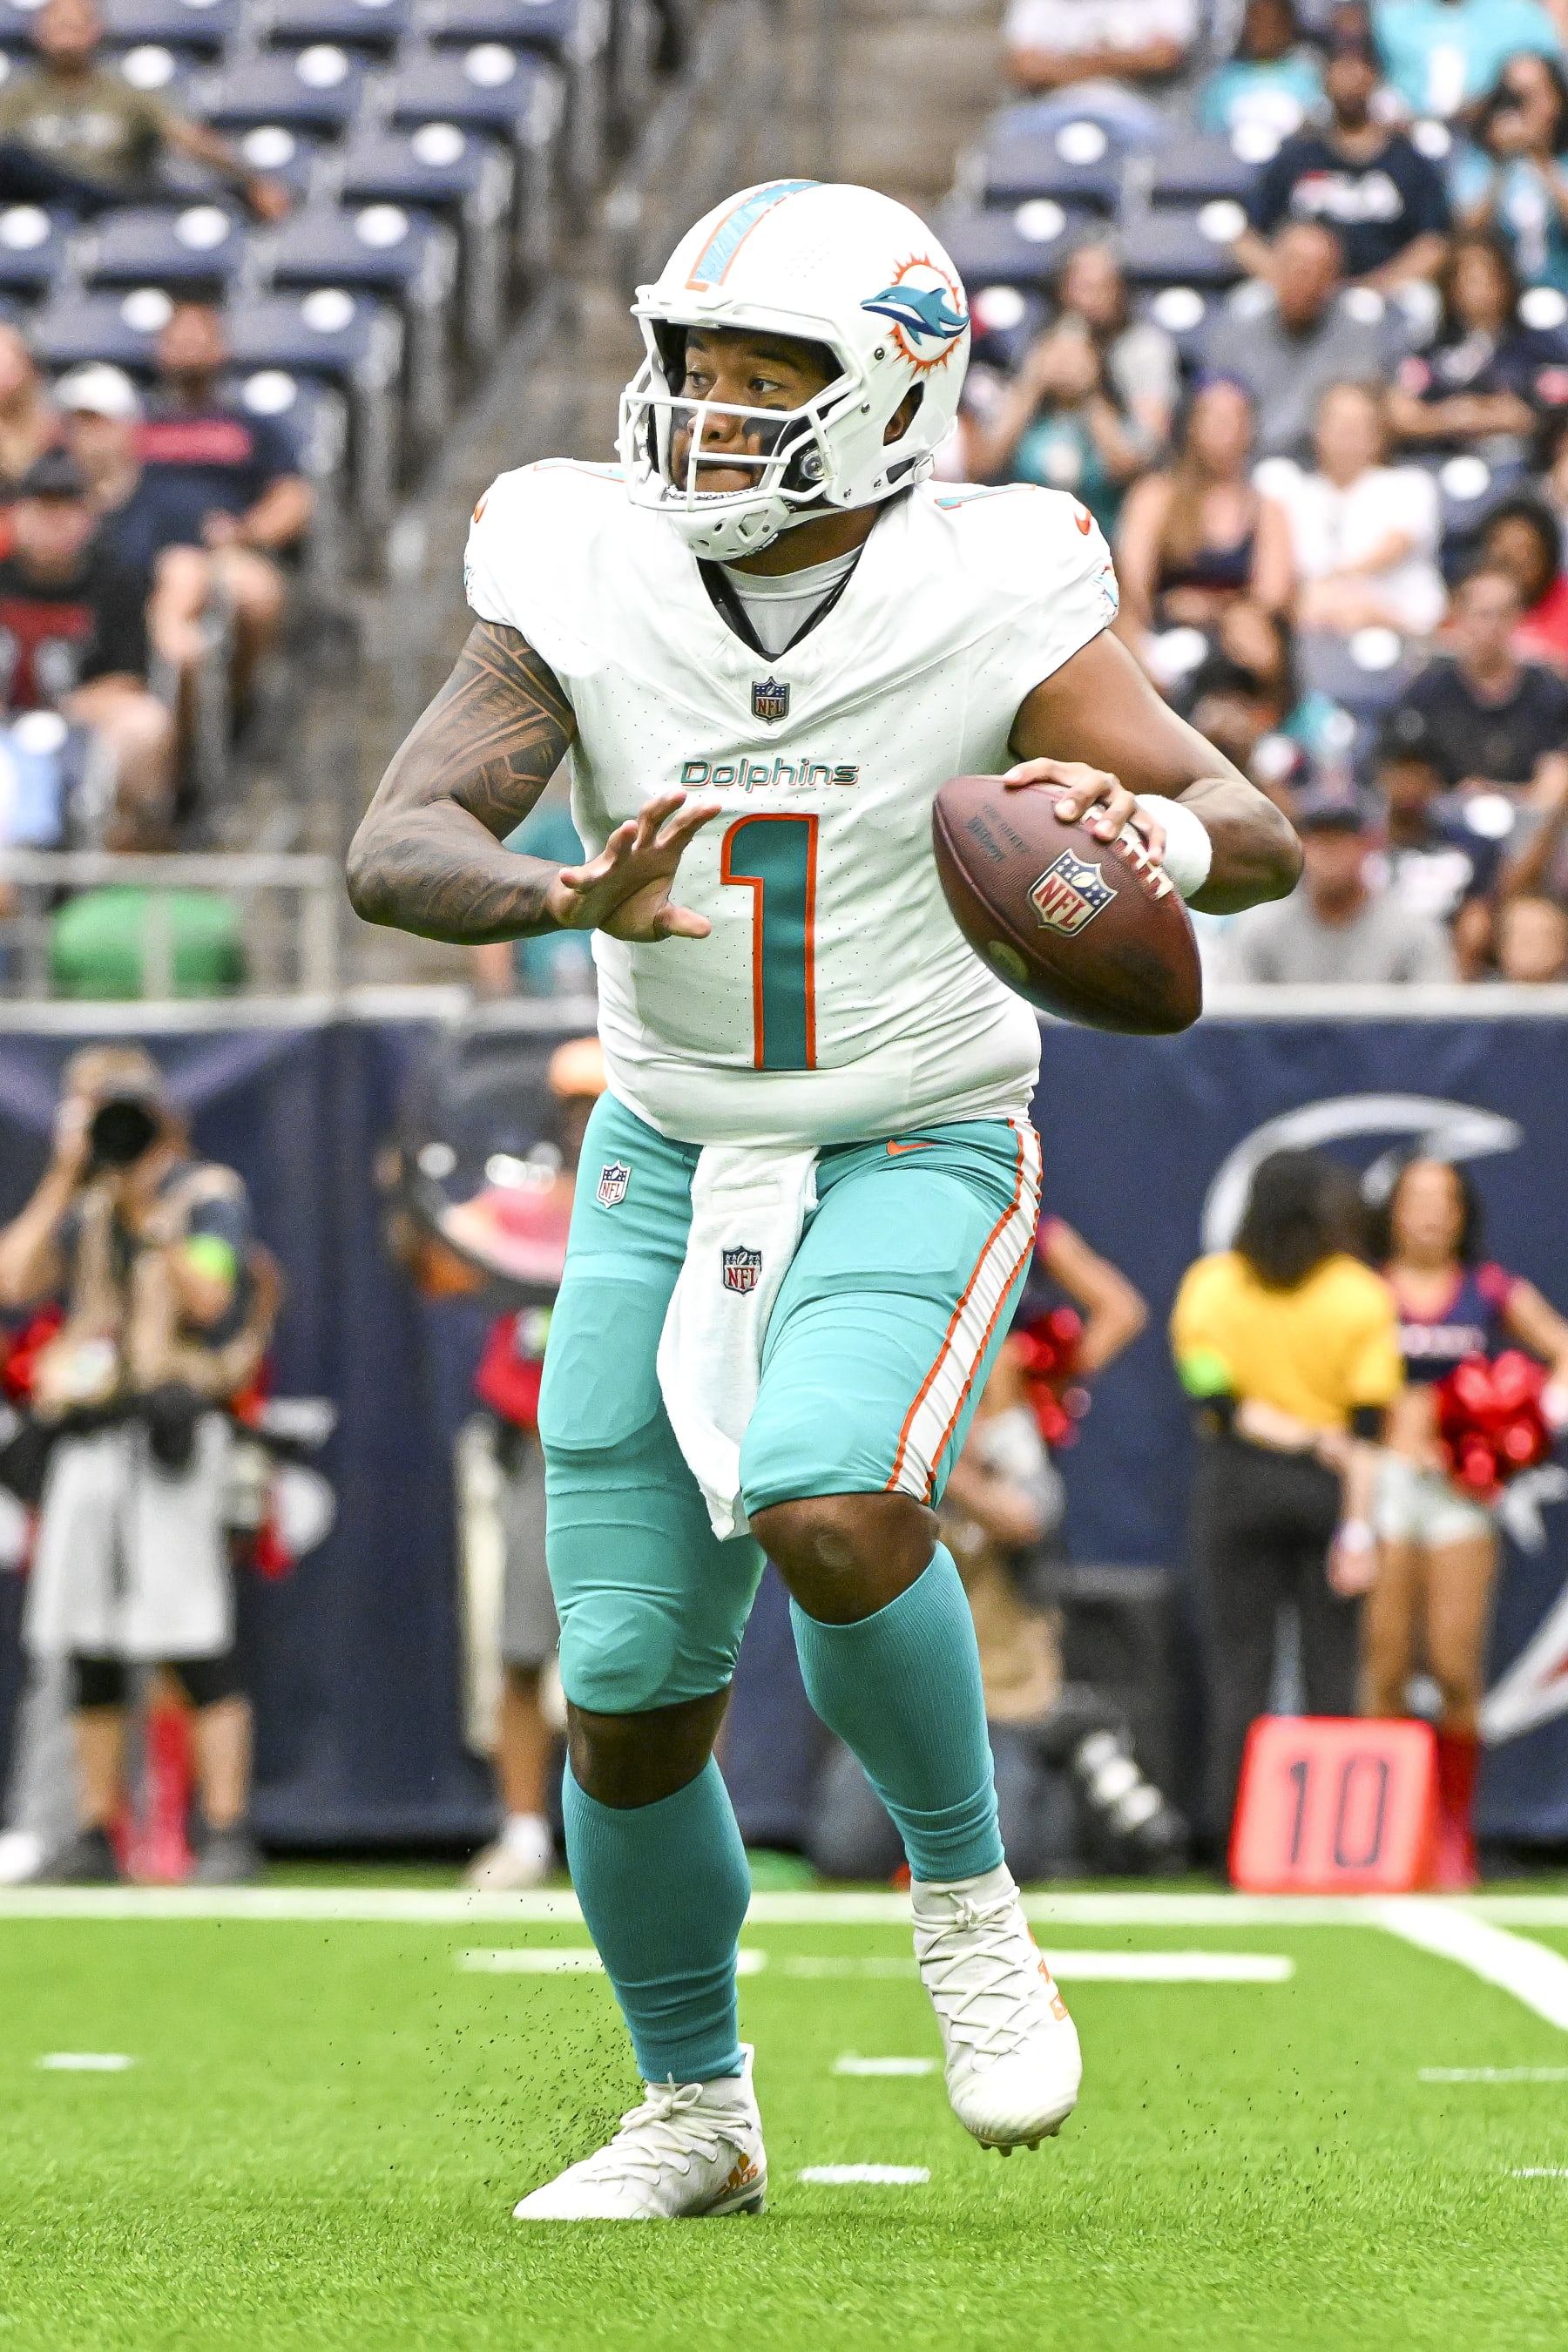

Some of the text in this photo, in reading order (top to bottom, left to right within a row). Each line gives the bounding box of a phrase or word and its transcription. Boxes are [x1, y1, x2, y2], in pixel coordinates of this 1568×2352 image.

[757, 698, 783, 714] NFL
[680, 757, 861, 794] Dolphins
[1034, 875, 1085, 929] NFL
[720, 813, 820, 1071] 1
[602, 1182, 620, 1200] NFL
[727, 1267, 758, 1289] NFL
[1289, 1757, 1390, 1869] 10
